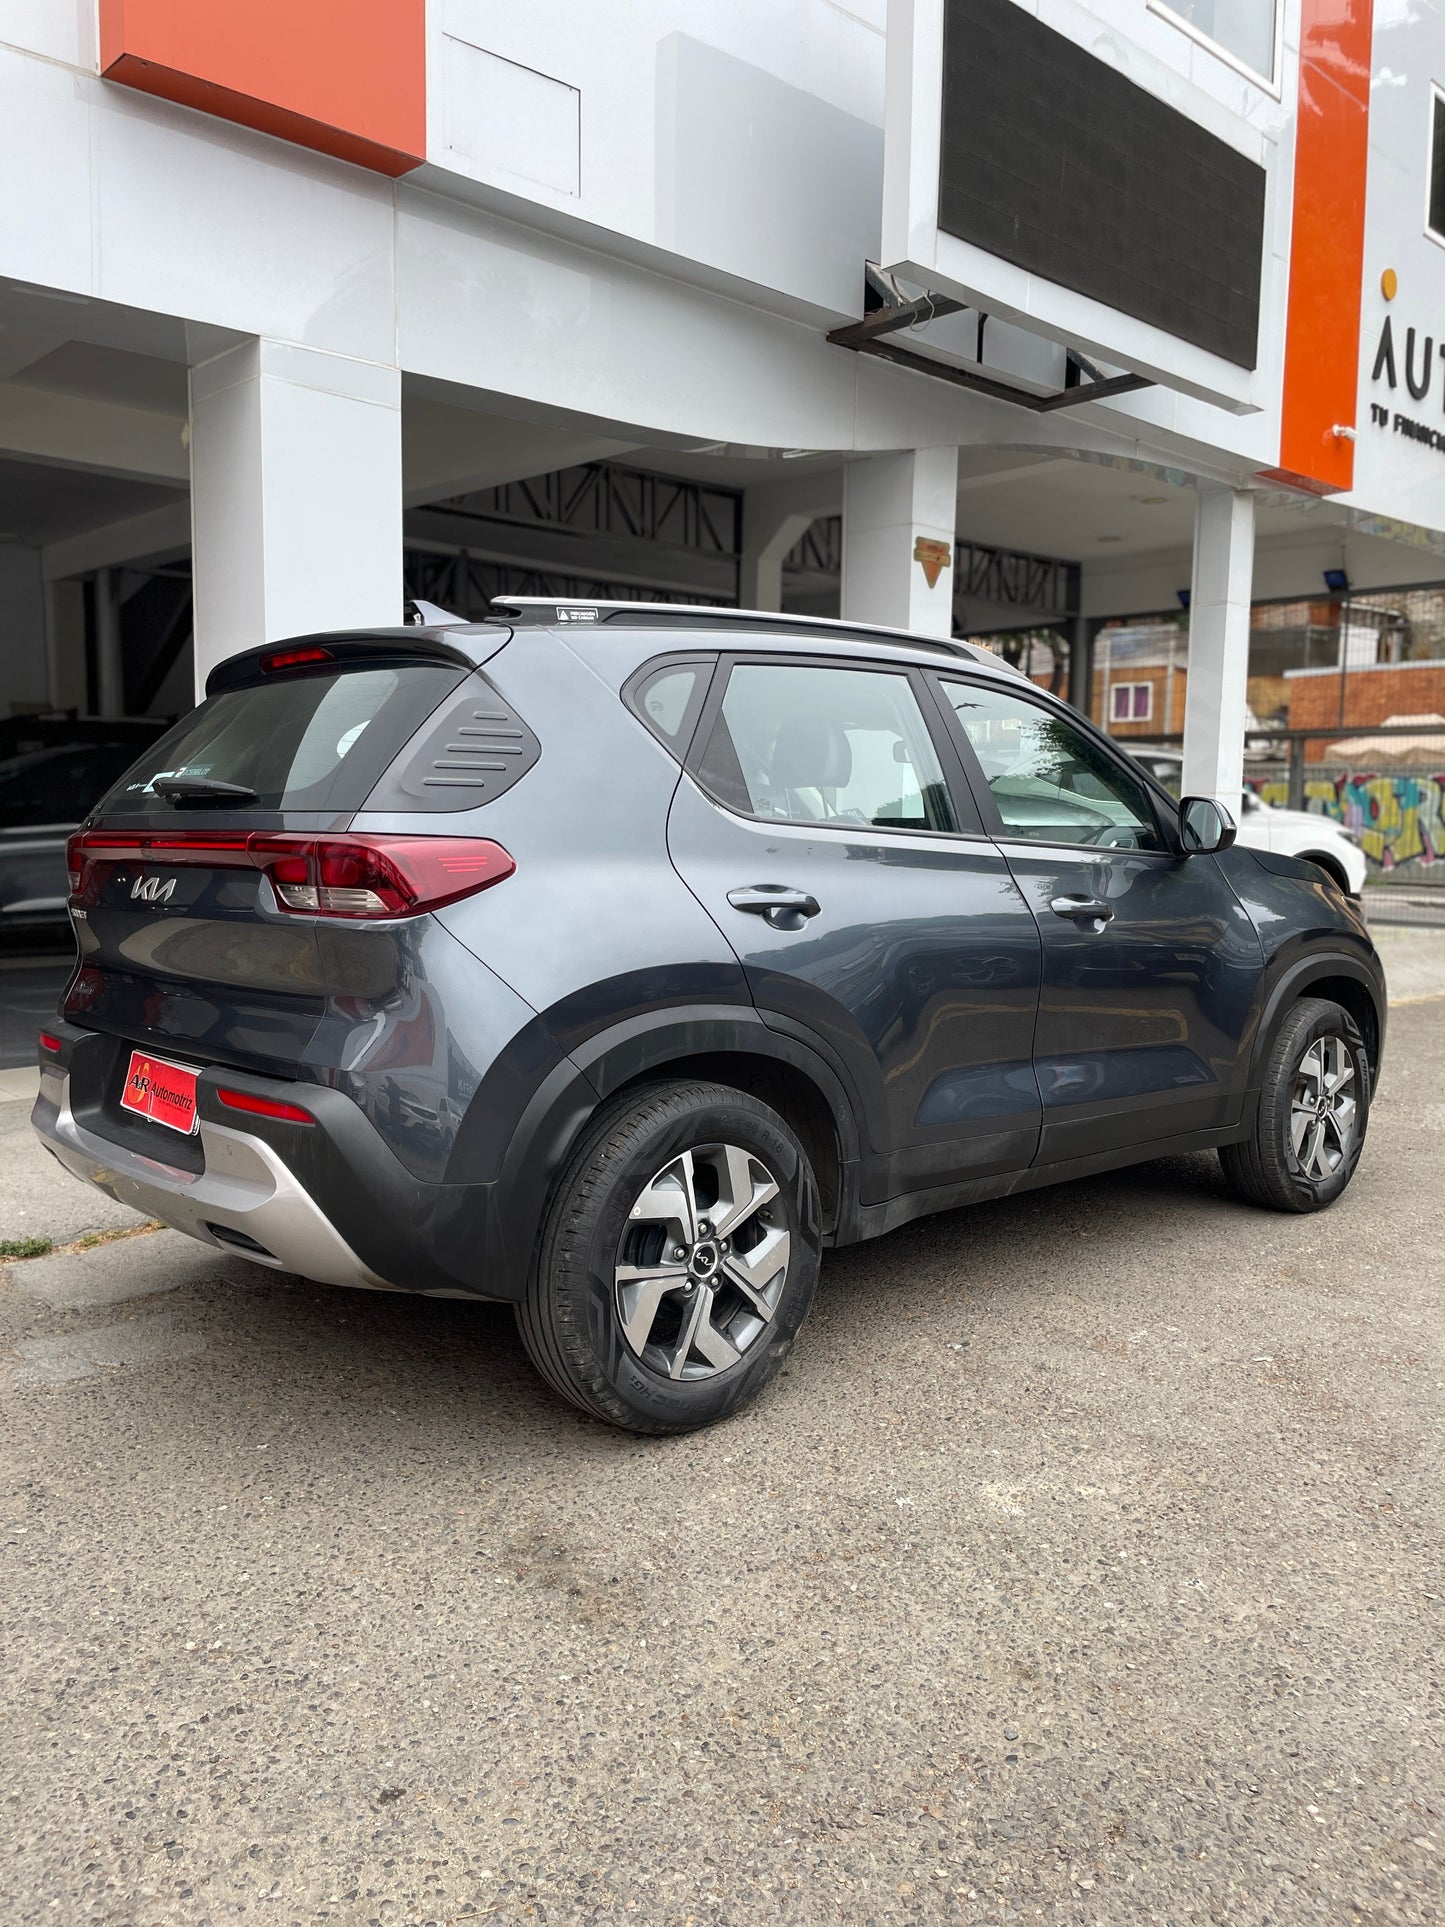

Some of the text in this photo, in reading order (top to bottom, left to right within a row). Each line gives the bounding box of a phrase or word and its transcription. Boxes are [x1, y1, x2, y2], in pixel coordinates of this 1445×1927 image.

[1370, 403, 1389, 428] TU
[130, 875, 177, 902] KIA
[151, 1082, 193, 1110] Automotriz
[695, 1251, 715, 1269] KIA
